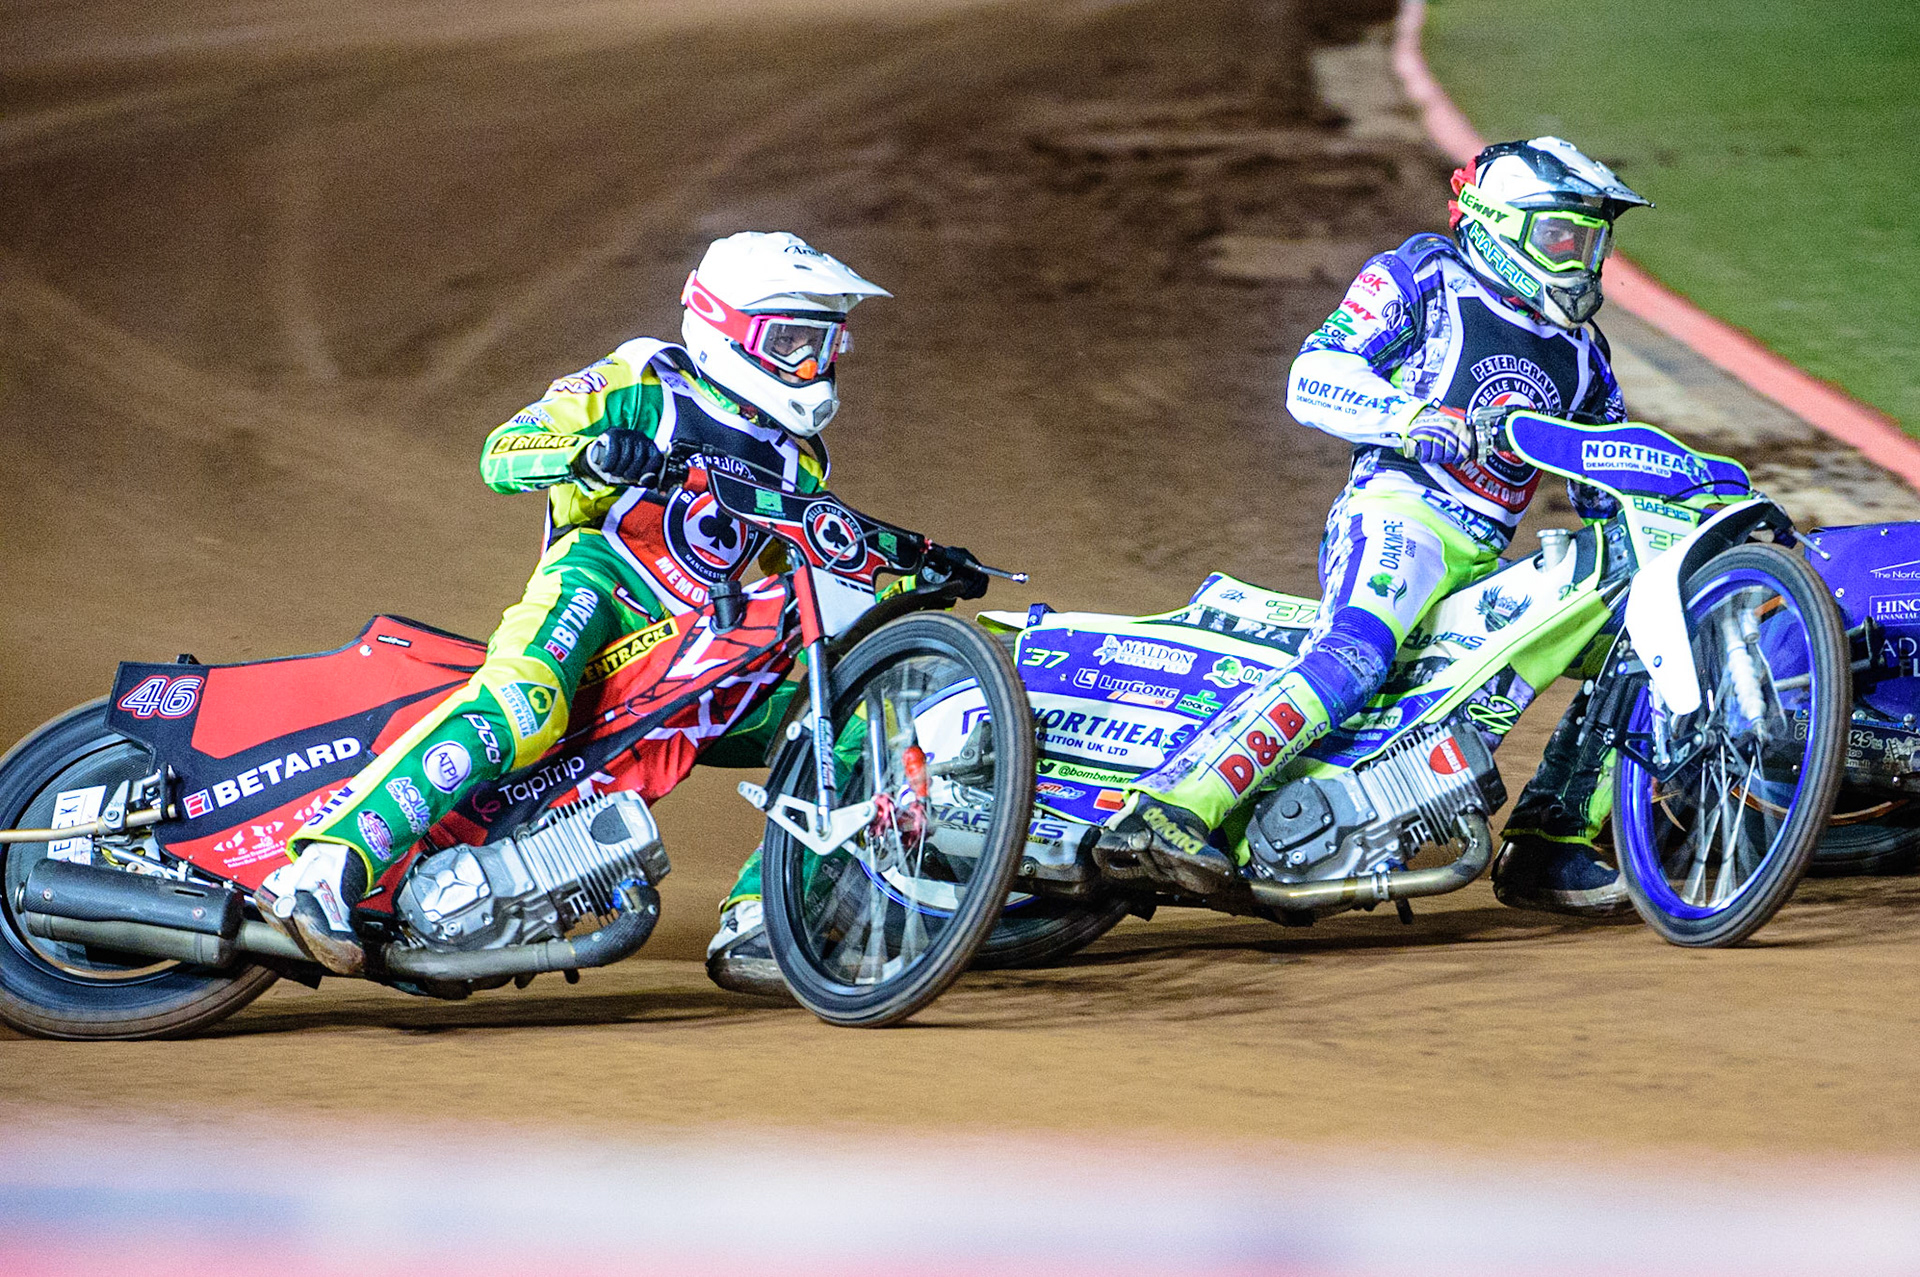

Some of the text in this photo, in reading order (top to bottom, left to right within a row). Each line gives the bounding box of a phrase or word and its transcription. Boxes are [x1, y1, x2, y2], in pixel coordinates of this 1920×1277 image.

[1461, 190, 1509, 223] LENNY
[1469, 222, 1540, 297] HARRIS
[1470, 354, 1518, 382] PETER
[1296, 395, 1332, 409] DEMOLITION
[1345, 407, 1357, 415] LTD
[1478, 380, 1534, 407] BELLE VUE
[1656, 468, 1669, 476] LTD
[807, 505, 861, 538] BELLE VUE ACES
[1633, 497, 1693, 522] HARRIS
[1122, 642, 1194, 665] MALDON
[118, 675, 204, 719] 46
[500, 683, 538, 738] MOTORCYCLING AUSTRALIA
[1180, 699, 1202, 710] ROCK
[1035, 731, 1128, 757] OLITION UK LTD
[1217, 702, 1306, 797] D&B
[212, 737, 362, 808] BETARD
[435, 752, 459, 782] ATPI
[499, 755, 586, 806] TapTrip
